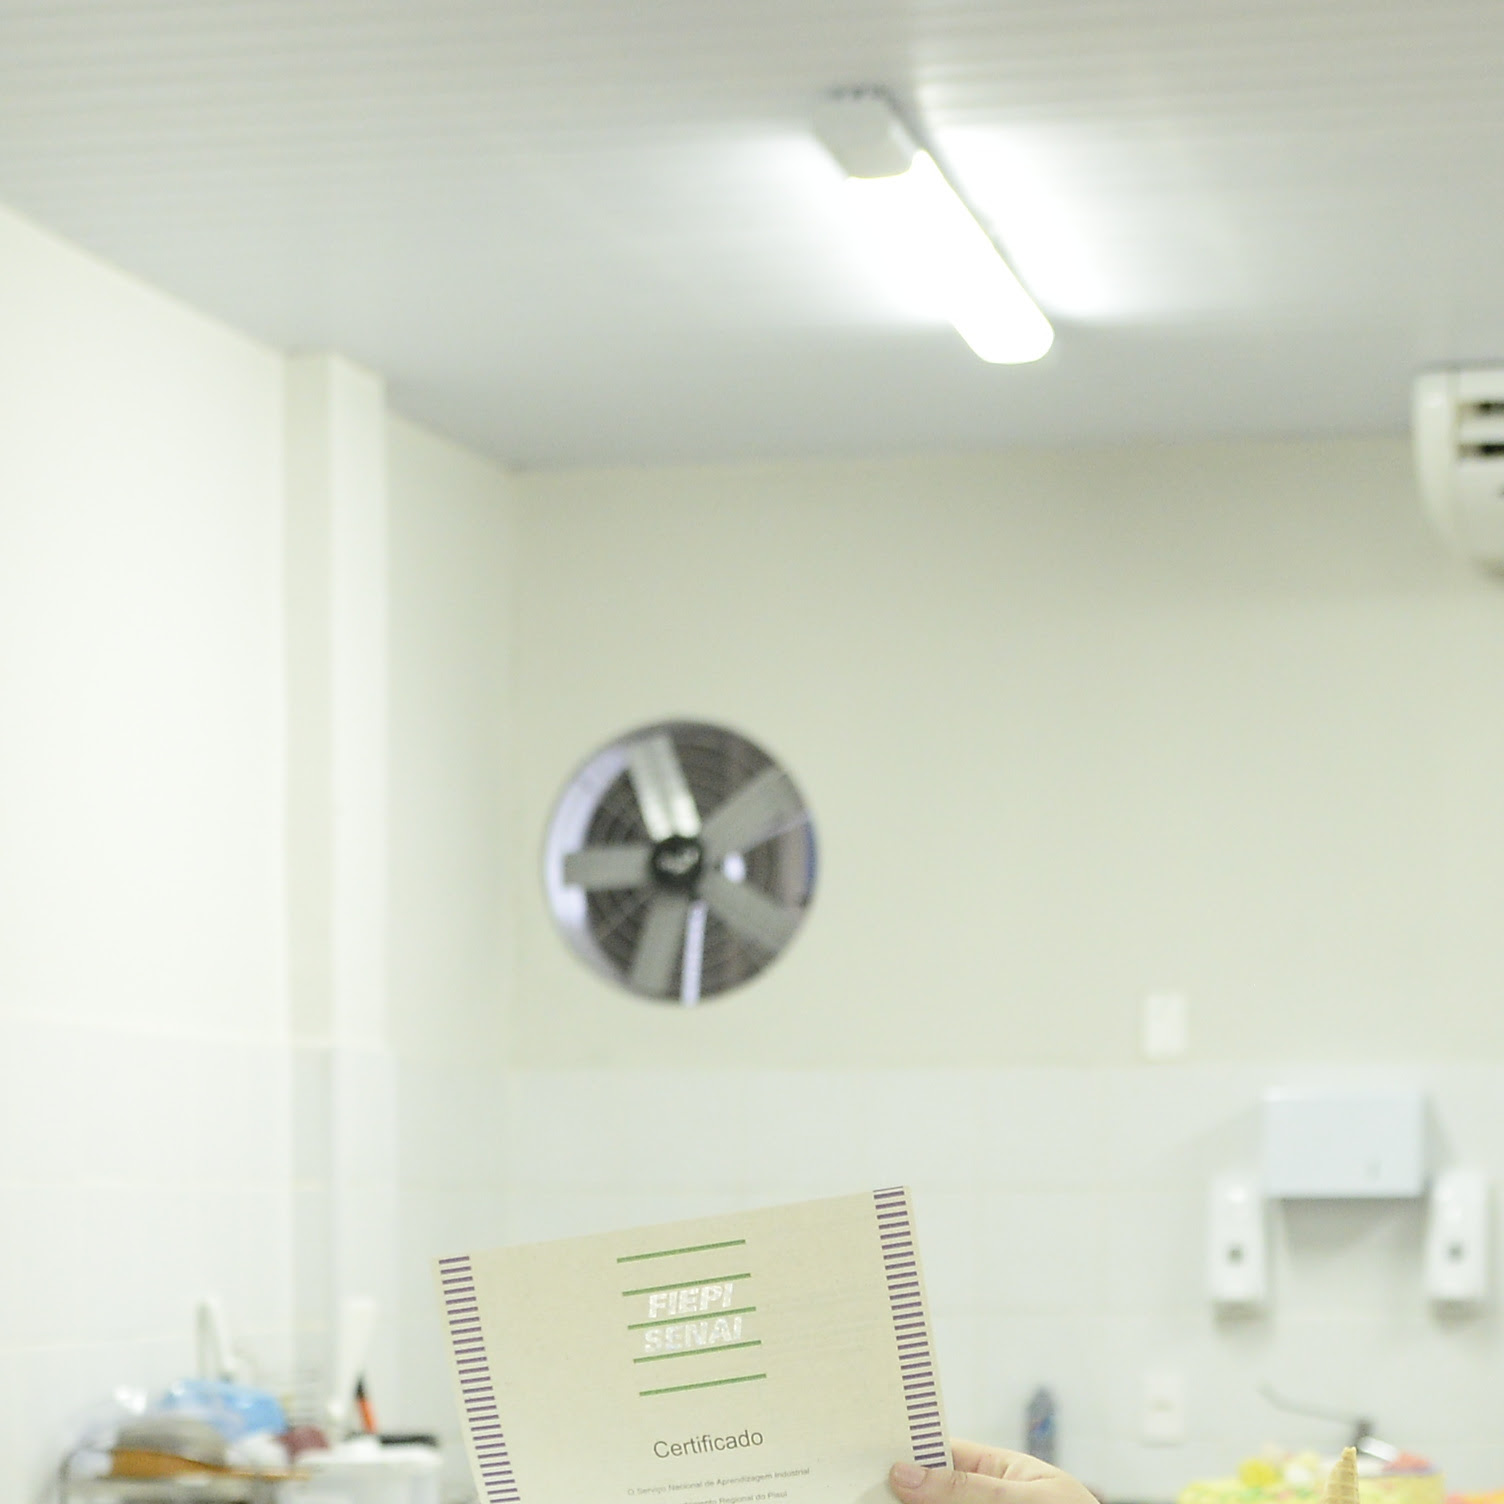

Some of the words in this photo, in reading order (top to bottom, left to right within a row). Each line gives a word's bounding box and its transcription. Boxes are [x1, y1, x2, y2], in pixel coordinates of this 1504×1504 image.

[648, 1283, 734, 1318] FIEPI
[645, 1317, 742, 1352] SENAI
[653, 1430, 764, 1458] Certificado
[668, 1480, 702, 1491] Nacional
[705, 1479, 714, 1487] de
[716, 1473, 773, 1487] Aprendizagem
[774, 1468, 810, 1479] Industrial
[719, 1494, 753, 1504] Regional
[755, 1493, 766, 1501] do
